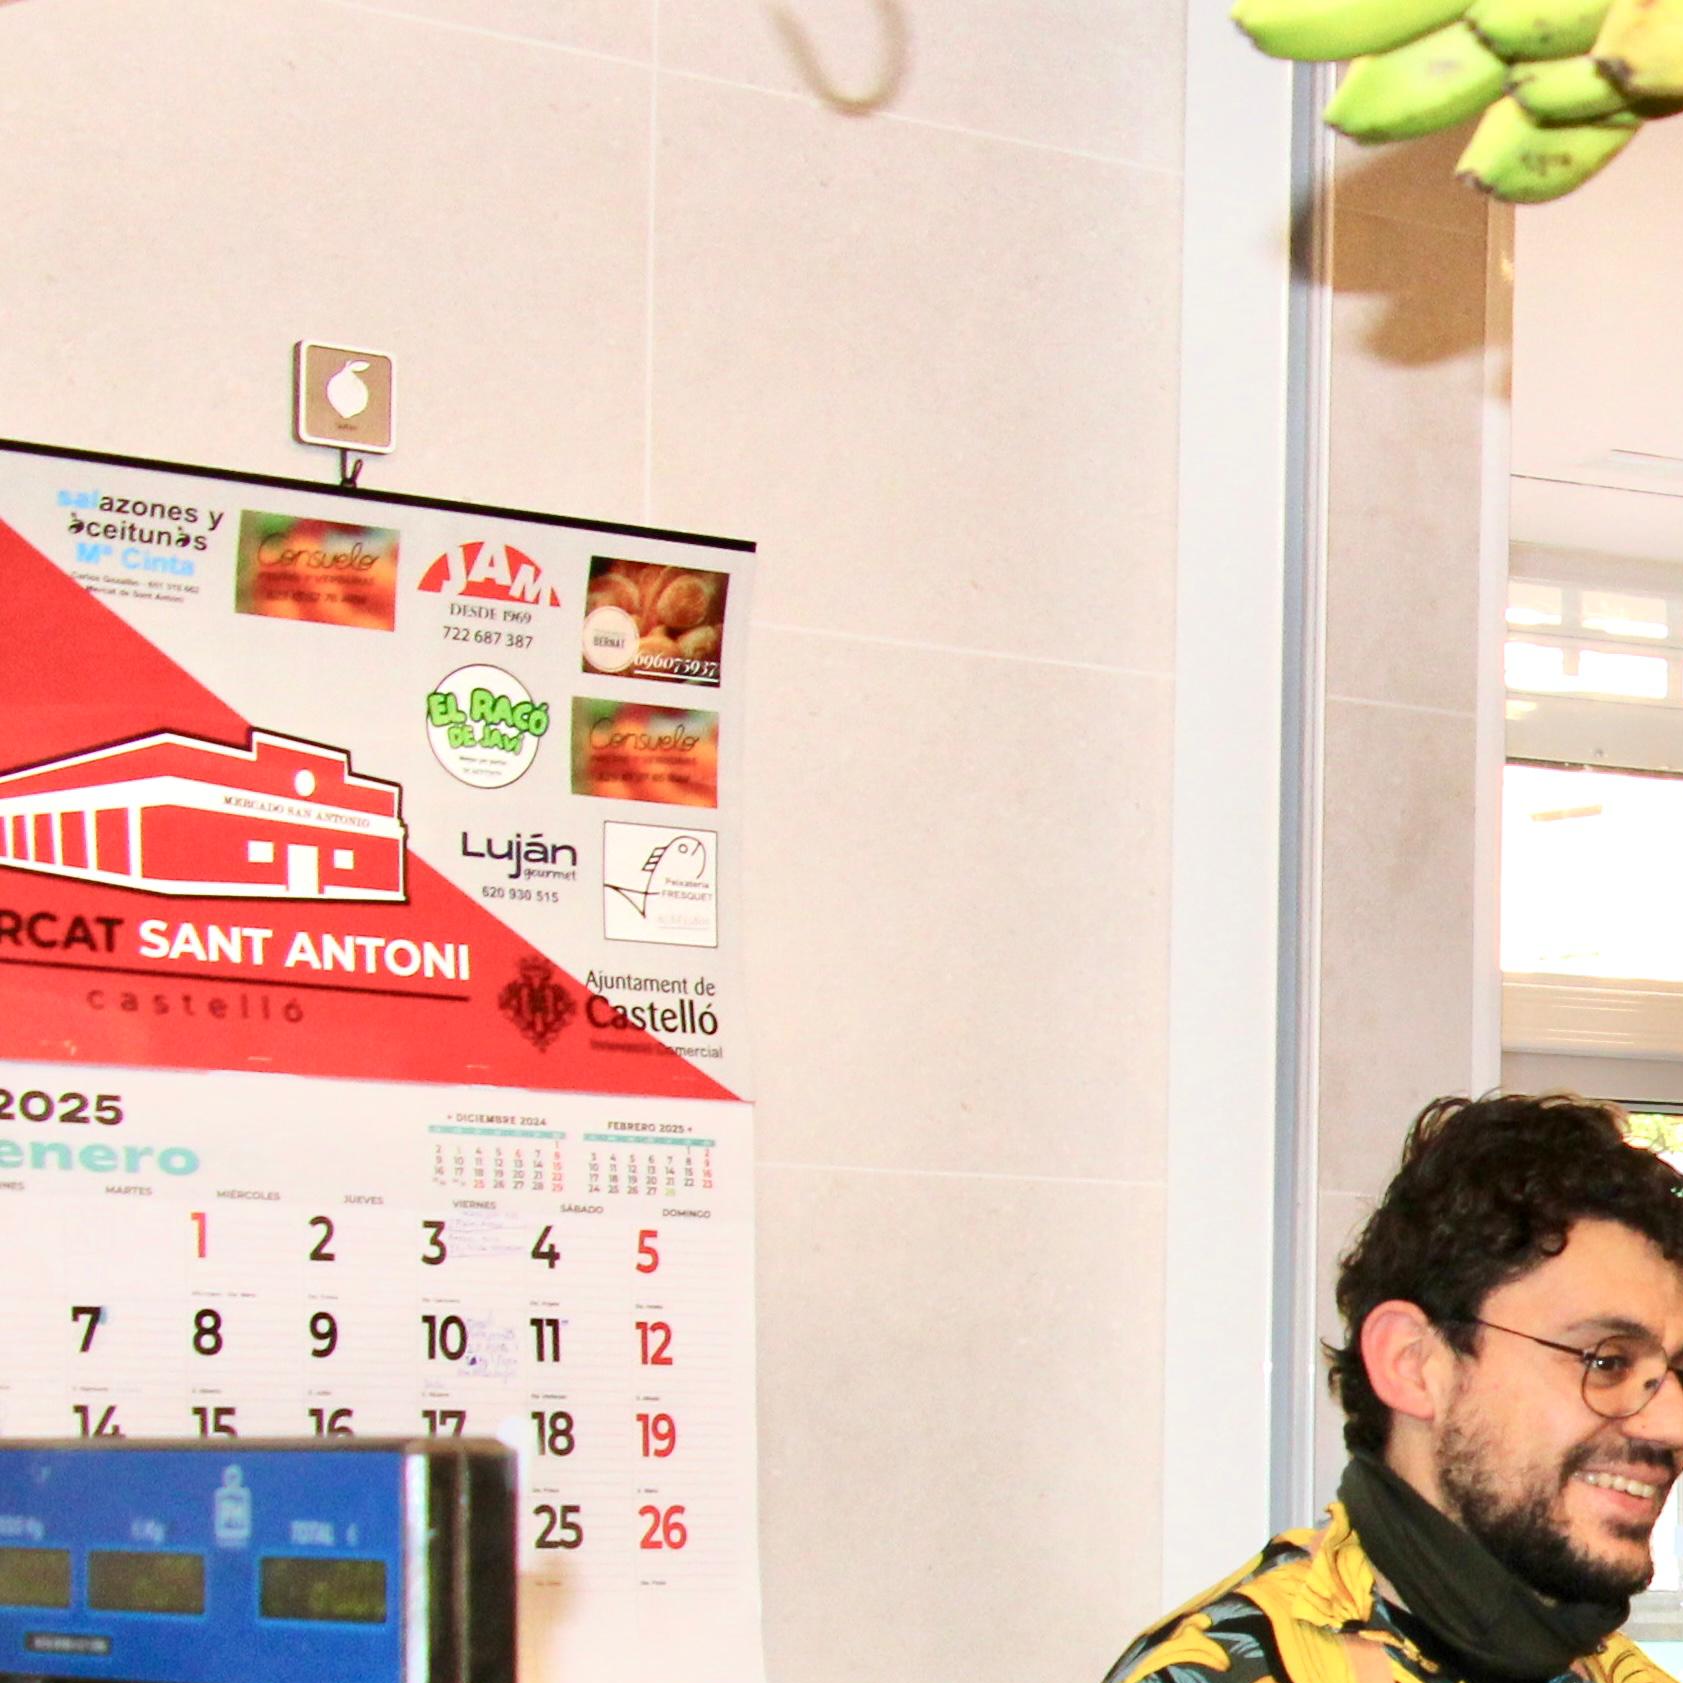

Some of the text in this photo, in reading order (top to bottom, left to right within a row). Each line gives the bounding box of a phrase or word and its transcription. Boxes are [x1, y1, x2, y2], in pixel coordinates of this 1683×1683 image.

[57, 489, 224, 531] salazones y
[450, 602, 532, 624] DESDE 1969
[442, 626, 534, 650] 722 687 387
[427, 690, 467, 728] EL
[461, 831, 577, 879] Luján
[536, 891, 559, 903] 515
[138, 919, 272, 966] SANT
[284, 931, 471, 981] ANTONI
[586, 970, 716, 997] Ajuntament de
[86, 987, 304, 1024] castelló
[586, 993, 719, 1036] Castelló
[456, 1112, 516, 1125] DICIEMBRE
[608, 1121, 656, 1132] FEBRERO
[662, 1208, 711, 1219] DOMINGO
[191, 1211, 206, 1257] 1
[309, 1215, 335, 1261] 2
[421, 1220, 447, 1265] 3
[531, 1225, 560, 1269] 4
[635, 1230, 659, 1274] 5
[72, 1306, 102, 1352] 7
[193, 1308, 223, 1356] 8
[309, 1311, 338, 1357] 9
[422, 1315, 468, 1360] 10
[530, 1318, 561, 1362] 11
[635, 1321, 673, 1365] 12
[531, 1411, 575, 1457] 18
[636, 1413, 676, 1457] 19
[533, 1504, 687, 1549] 25 26
